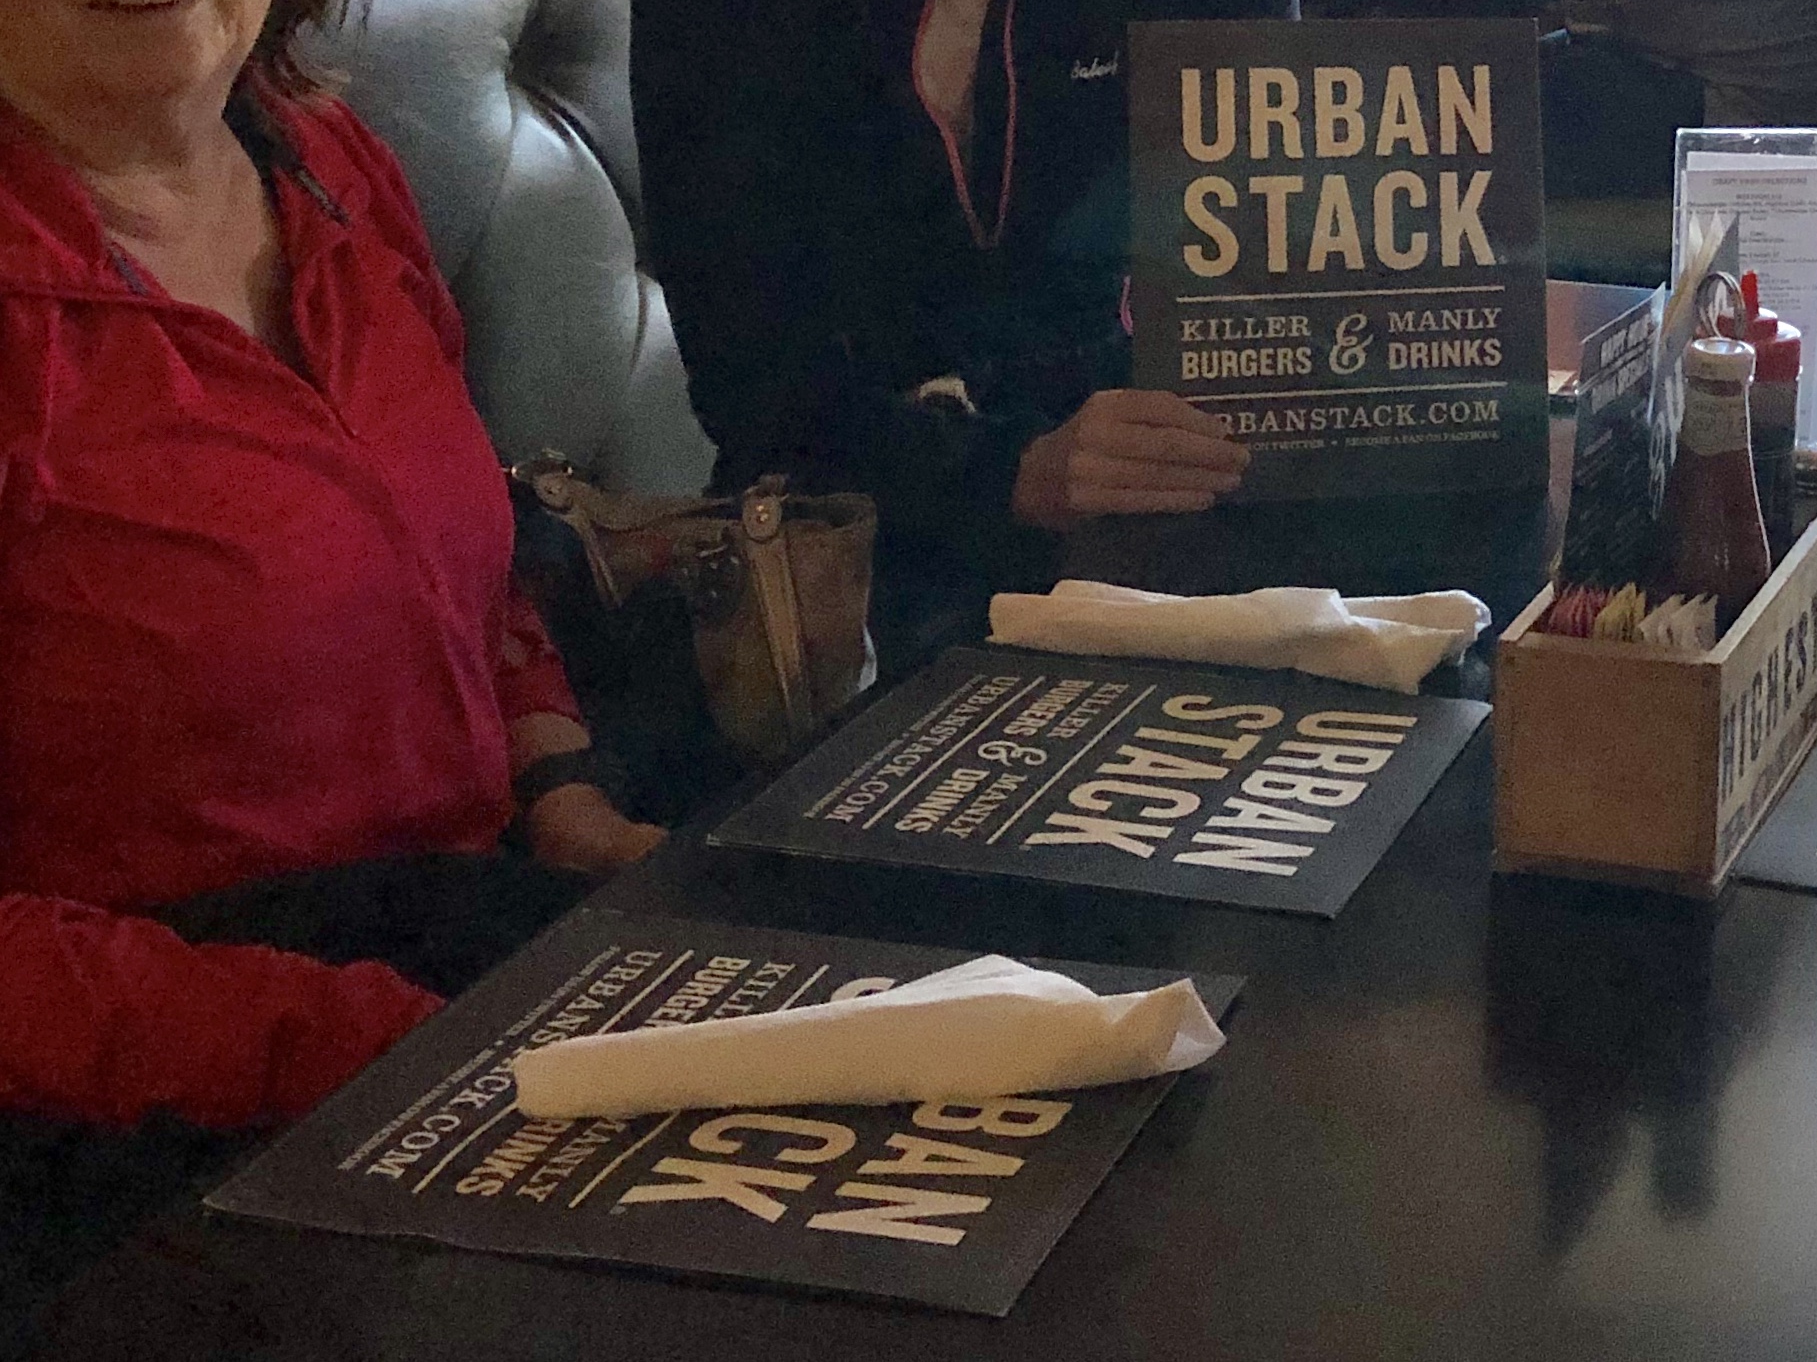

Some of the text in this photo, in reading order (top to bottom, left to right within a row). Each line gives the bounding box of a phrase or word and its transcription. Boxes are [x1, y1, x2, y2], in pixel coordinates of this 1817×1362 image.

[1181, 65, 1492, 162] URBAN
[1183, 170, 1497, 277] STACK
[1181, 315, 1311, 342] KILLER
[1329, 313, 1374, 374] &
[1388, 307, 1502, 334] MANLY
[1182, 346, 1312, 380] BURGERS
[1388, 338, 1502, 371] DRINKS
[1216, 399, 1500, 434] RBANSTACK.COM
[1004, 679, 1094, 736] BURGERS
[1047, 682, 1128, 738] KILLER
[824, 676, 1020, 824] URBANSTACK.COM
[1026, 694, 1283, 859] STACK
[894, 768, 990, 833] DRINKS
[943, 773, 1027, 838] MANLY
[1173, 711, 1417, 875] URBAN
[643, 956, 750, 1030] BURGE
[706, 961, 796, 1021] KILL
[365, 950, 662, 1179] URBANSCK.COM
[455, 1119, 573, 1197] RINKS
[806, 1097, 1073, 1246] BAN
